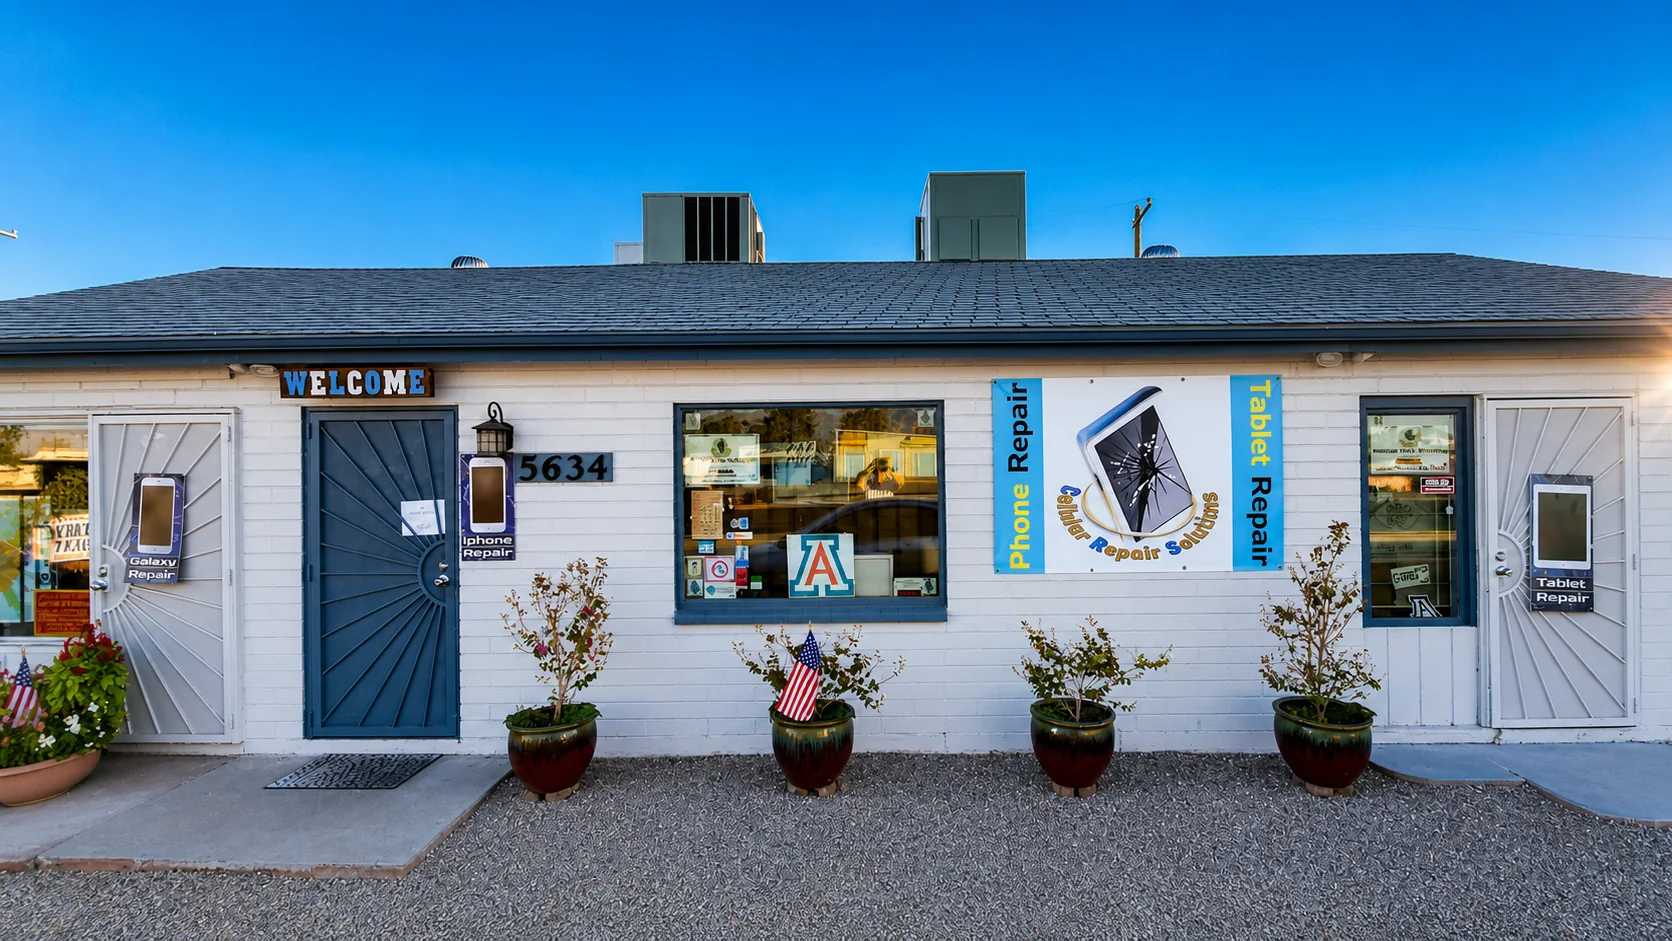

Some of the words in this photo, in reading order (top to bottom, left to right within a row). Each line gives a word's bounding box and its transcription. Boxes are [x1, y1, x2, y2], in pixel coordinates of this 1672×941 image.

[283, 369, 425, 396] WELCOME
[1007, 381, 1034, 473] Repair
[1249, 379, 1273, 467] Tablet
[518, 453, 608, 482] 5634
[1009, 483, 1031, 570] Phone
[1246, 476, 1273, 567] Repair
[463, 536, 512, 547] Iphone
[464, 548, 513, 558] Repair
[1089, 536, 1161, 563] Repair
[128, 569, 175, 581] Repair
[130, 557, 177, 567] Galaxy
[1535, 577, 1587, 589] Tablet
[1536, 592, 1590, 605] Repair
